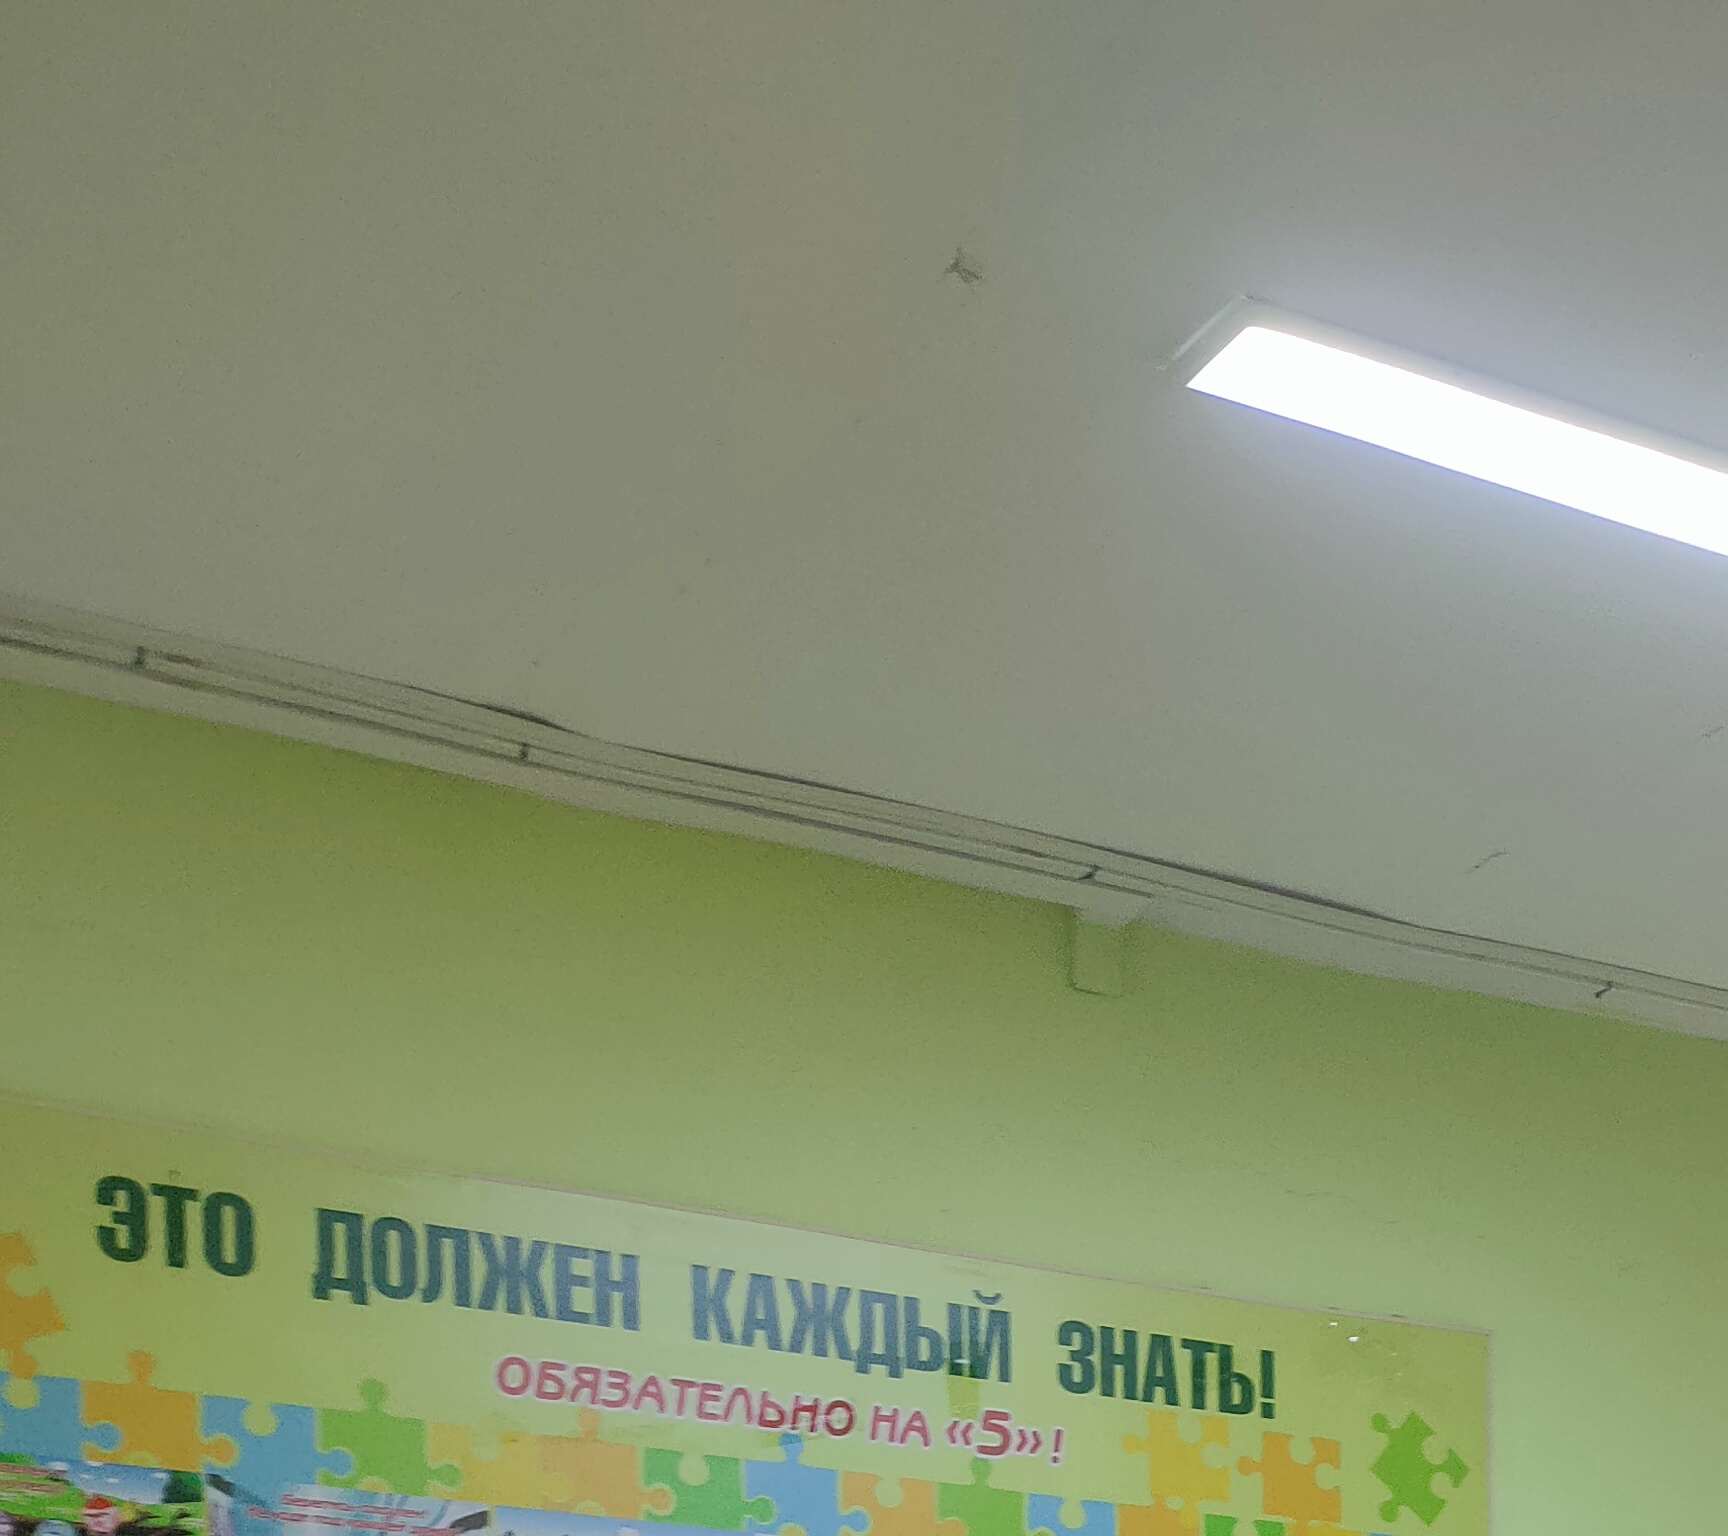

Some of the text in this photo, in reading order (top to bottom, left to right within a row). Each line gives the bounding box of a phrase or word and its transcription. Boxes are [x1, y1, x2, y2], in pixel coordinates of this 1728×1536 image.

[94, 1175, 1275, 1420] ЭТО ДОЛЖЕН КАЖДЫЙ ЗНАТЬ!
[496, 1355, 856, 1437] ОБЯЗАТЕЛЬНО
[869, 1406, 931, 1448] НА
